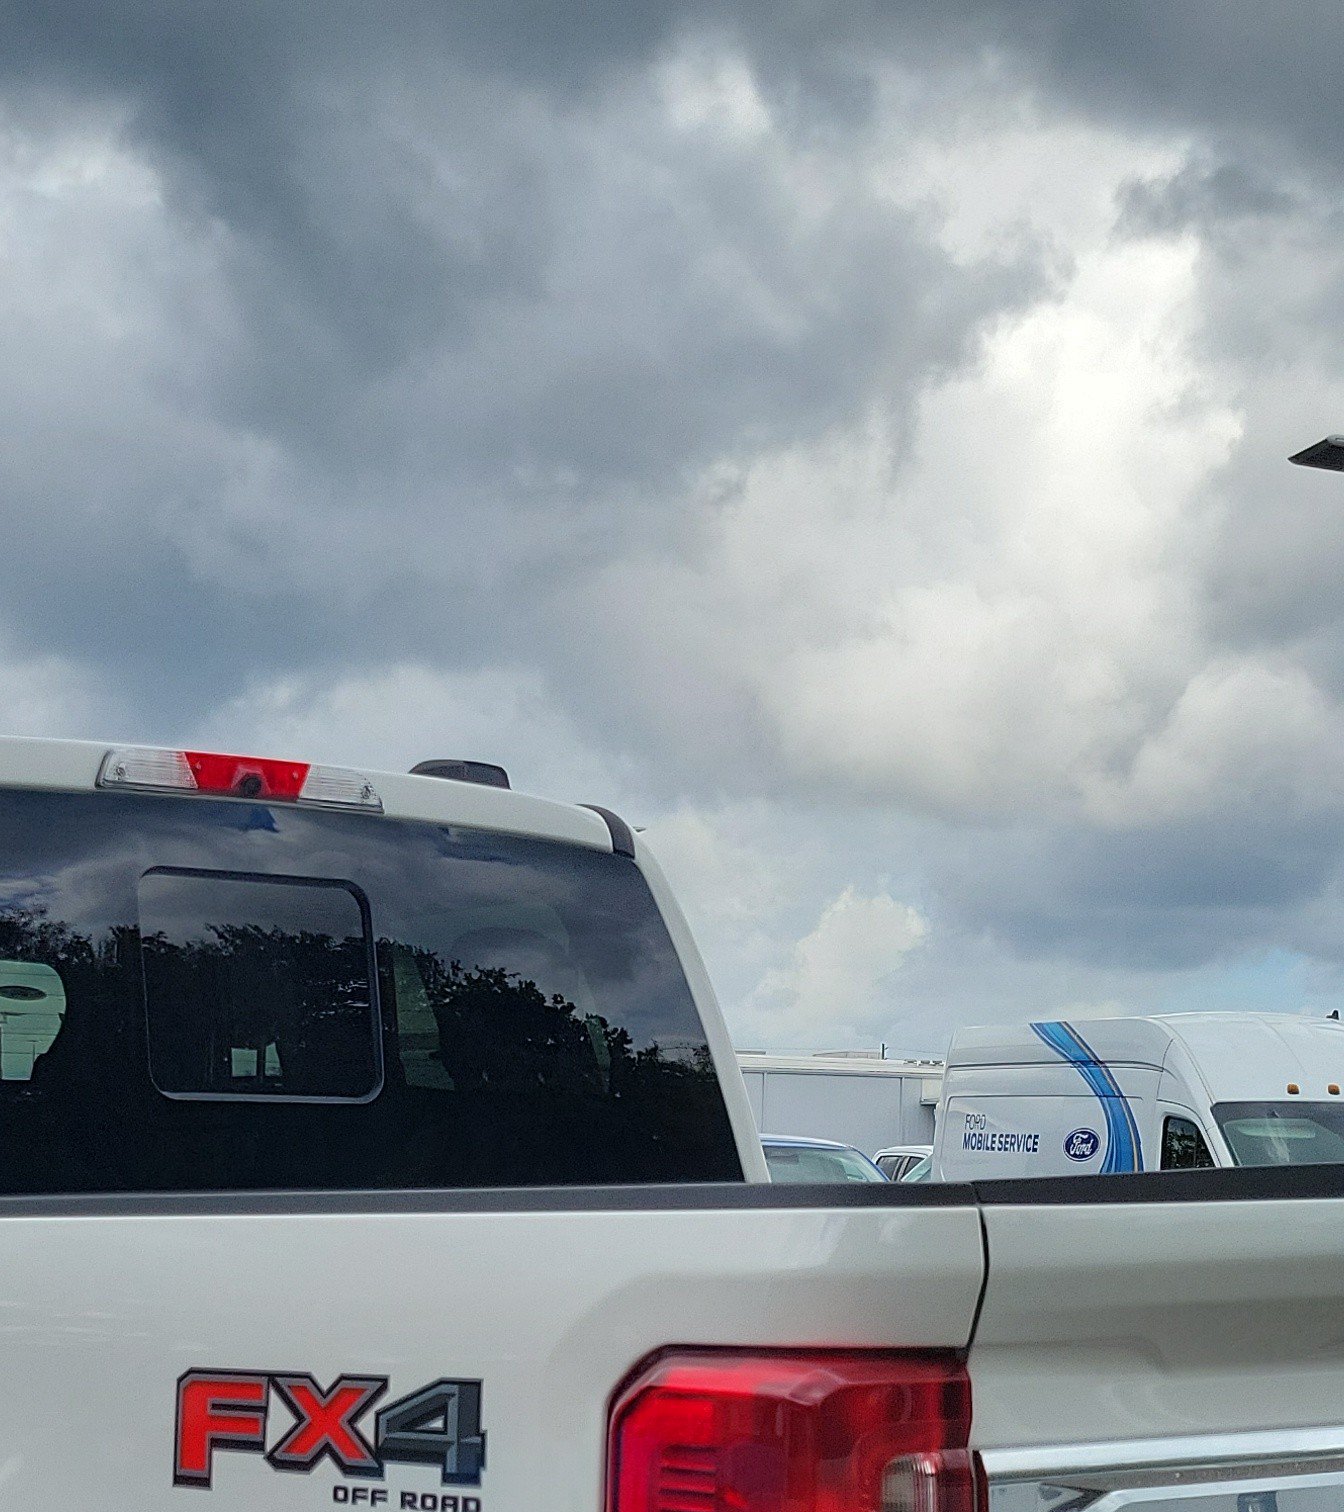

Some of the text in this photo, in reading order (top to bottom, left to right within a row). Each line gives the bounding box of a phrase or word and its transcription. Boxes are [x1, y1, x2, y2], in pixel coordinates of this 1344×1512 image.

[965, 1113, 987, 1130] FORD
[962, 1132, 1040, 1153] MOBILE SERVICE
[172, 1367, 486, 1490] FX4
[332, 1484, 389, 1508] OFF
